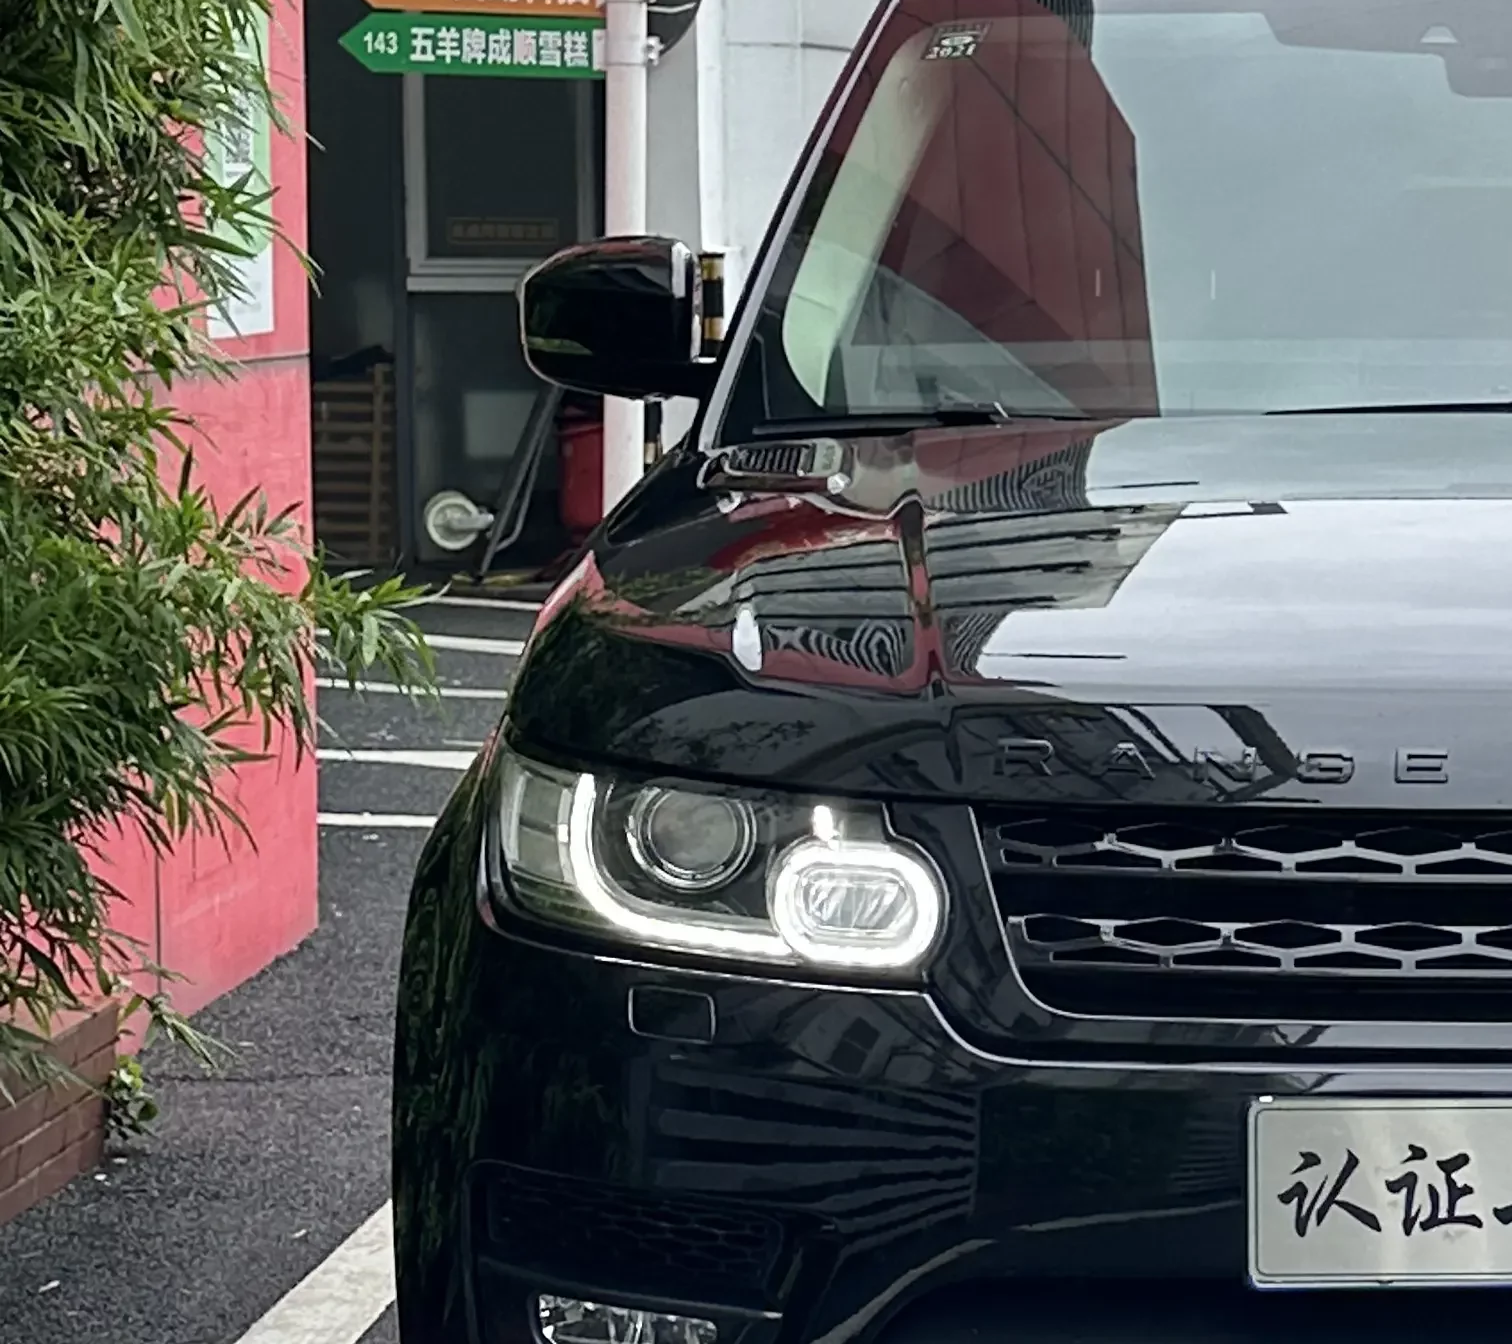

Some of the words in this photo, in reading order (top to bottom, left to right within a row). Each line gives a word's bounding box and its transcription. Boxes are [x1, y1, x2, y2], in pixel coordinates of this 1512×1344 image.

[363, 31, 398, 55] 143
[409, 26, 589, 68] 五羊牌成顺雪糕
[994, 737, 1449, 785] RANGE
